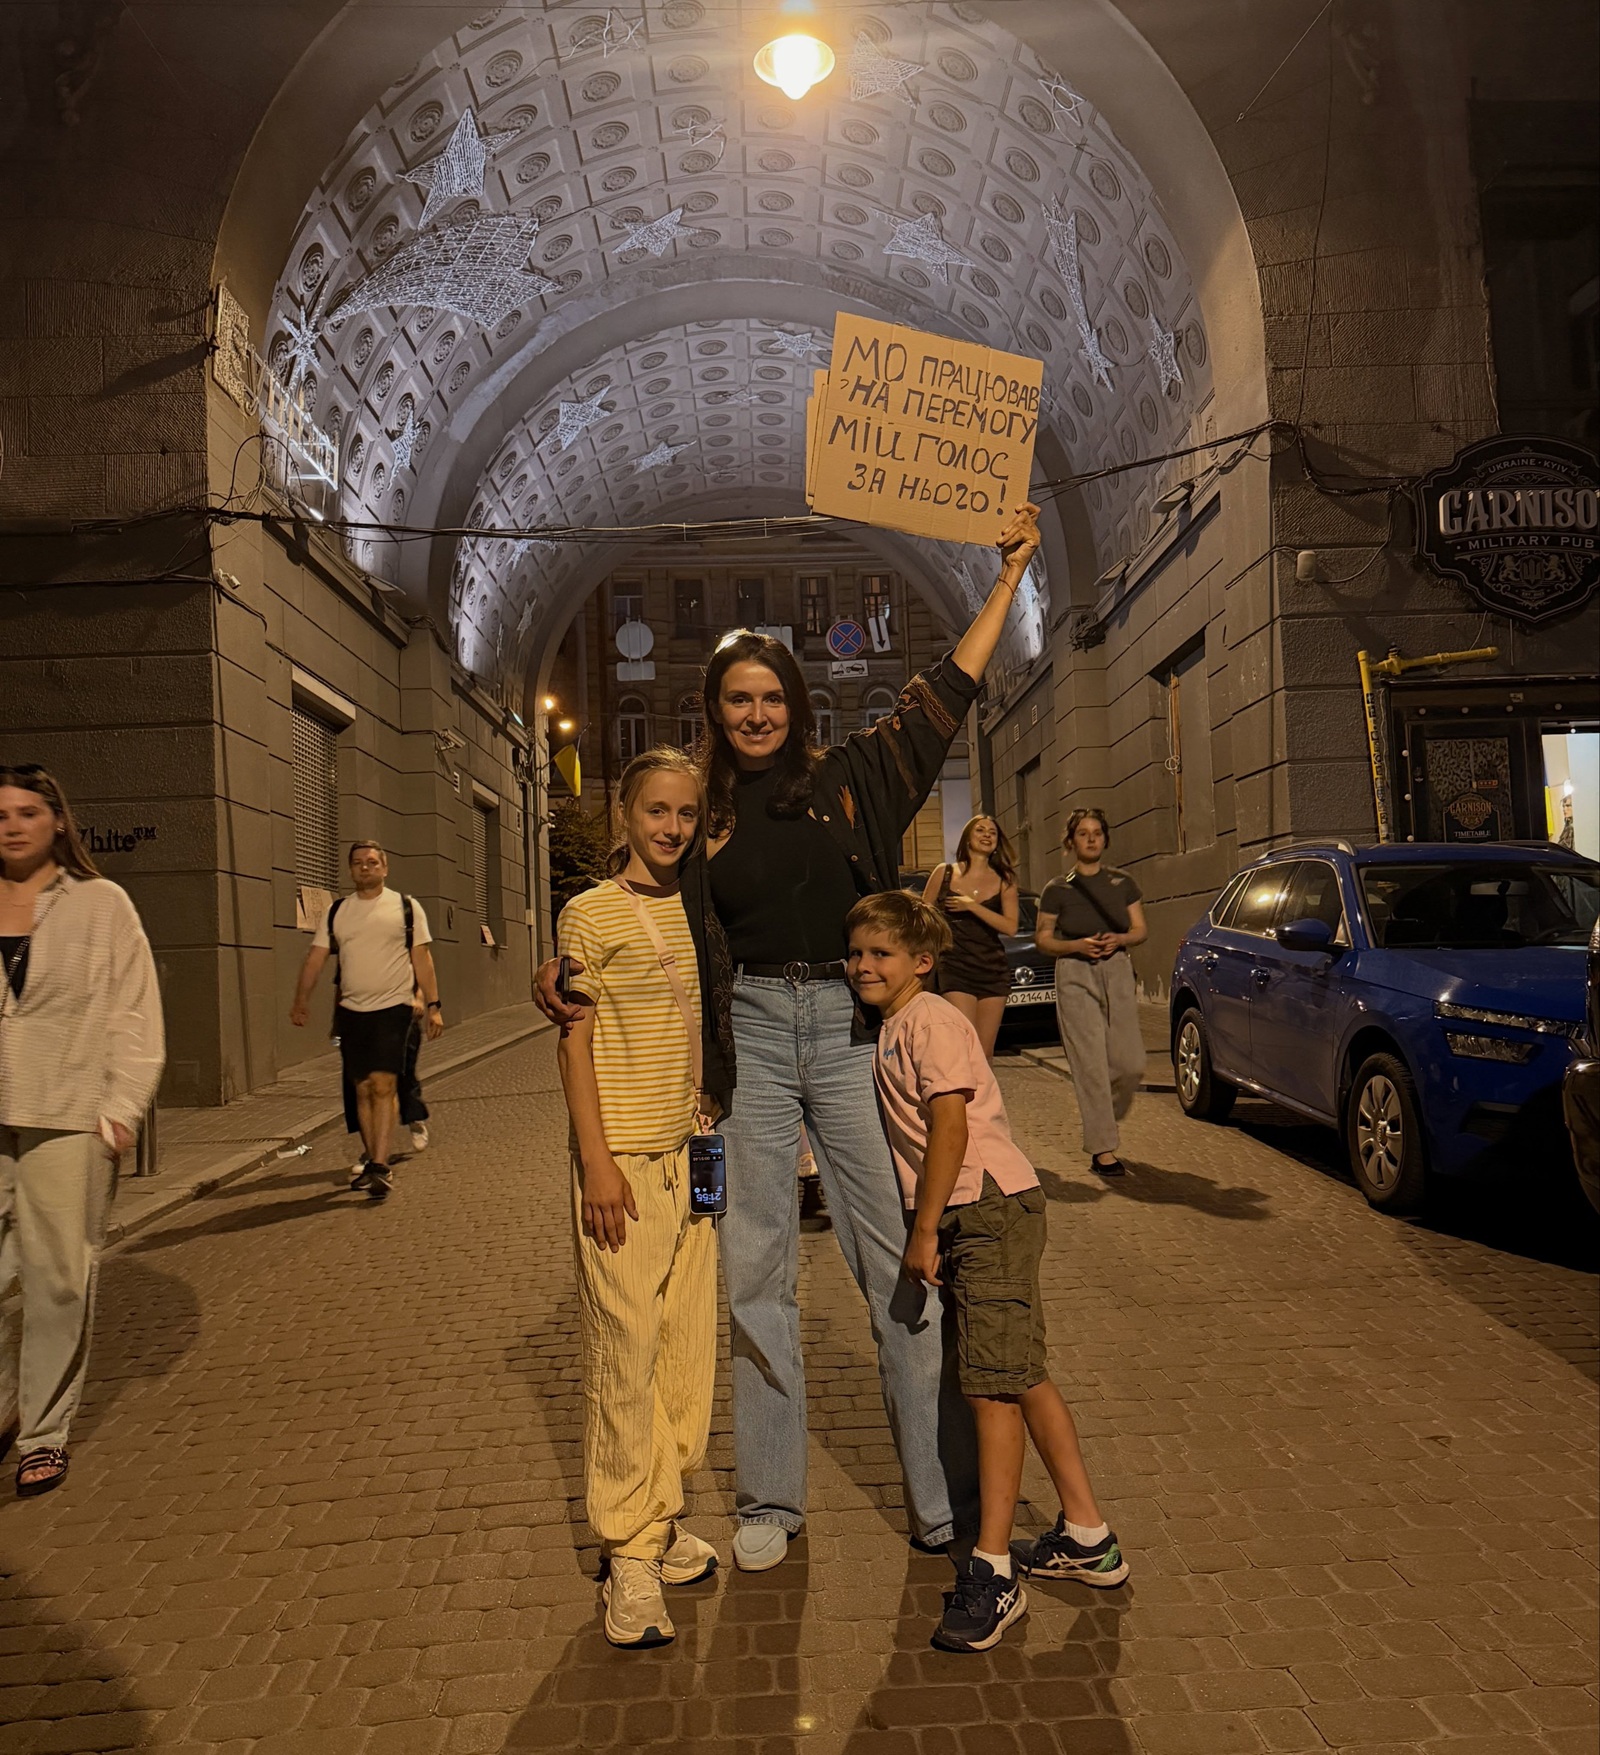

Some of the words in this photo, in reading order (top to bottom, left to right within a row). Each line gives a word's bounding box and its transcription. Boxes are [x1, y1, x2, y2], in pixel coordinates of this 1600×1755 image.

[842, 336, 907, 383] МО
[919, 356, 1040, 412] ПРАЦЮВАВ
[903, 389, 1038, 444] ПЕРЕМОГУ
[914, 433, 1009, 480] ГОЛОС
[1488, 458, 1536, 474] UKRAINE
[1543, 459, 1569, 473] KYIV
[847, 464, 886, 494] ЗА
[1439, 488, 1600, 536] GARNISO
[1468, 536, 1551, 550] MILITARY
[1560, 536, 1595, 549] PUB
[1449, 801, 1492, 814] GARNISON
[1454, 830, 1491, 838] TIMETABLE
[1020, 992, 1042, 1003] 2144
